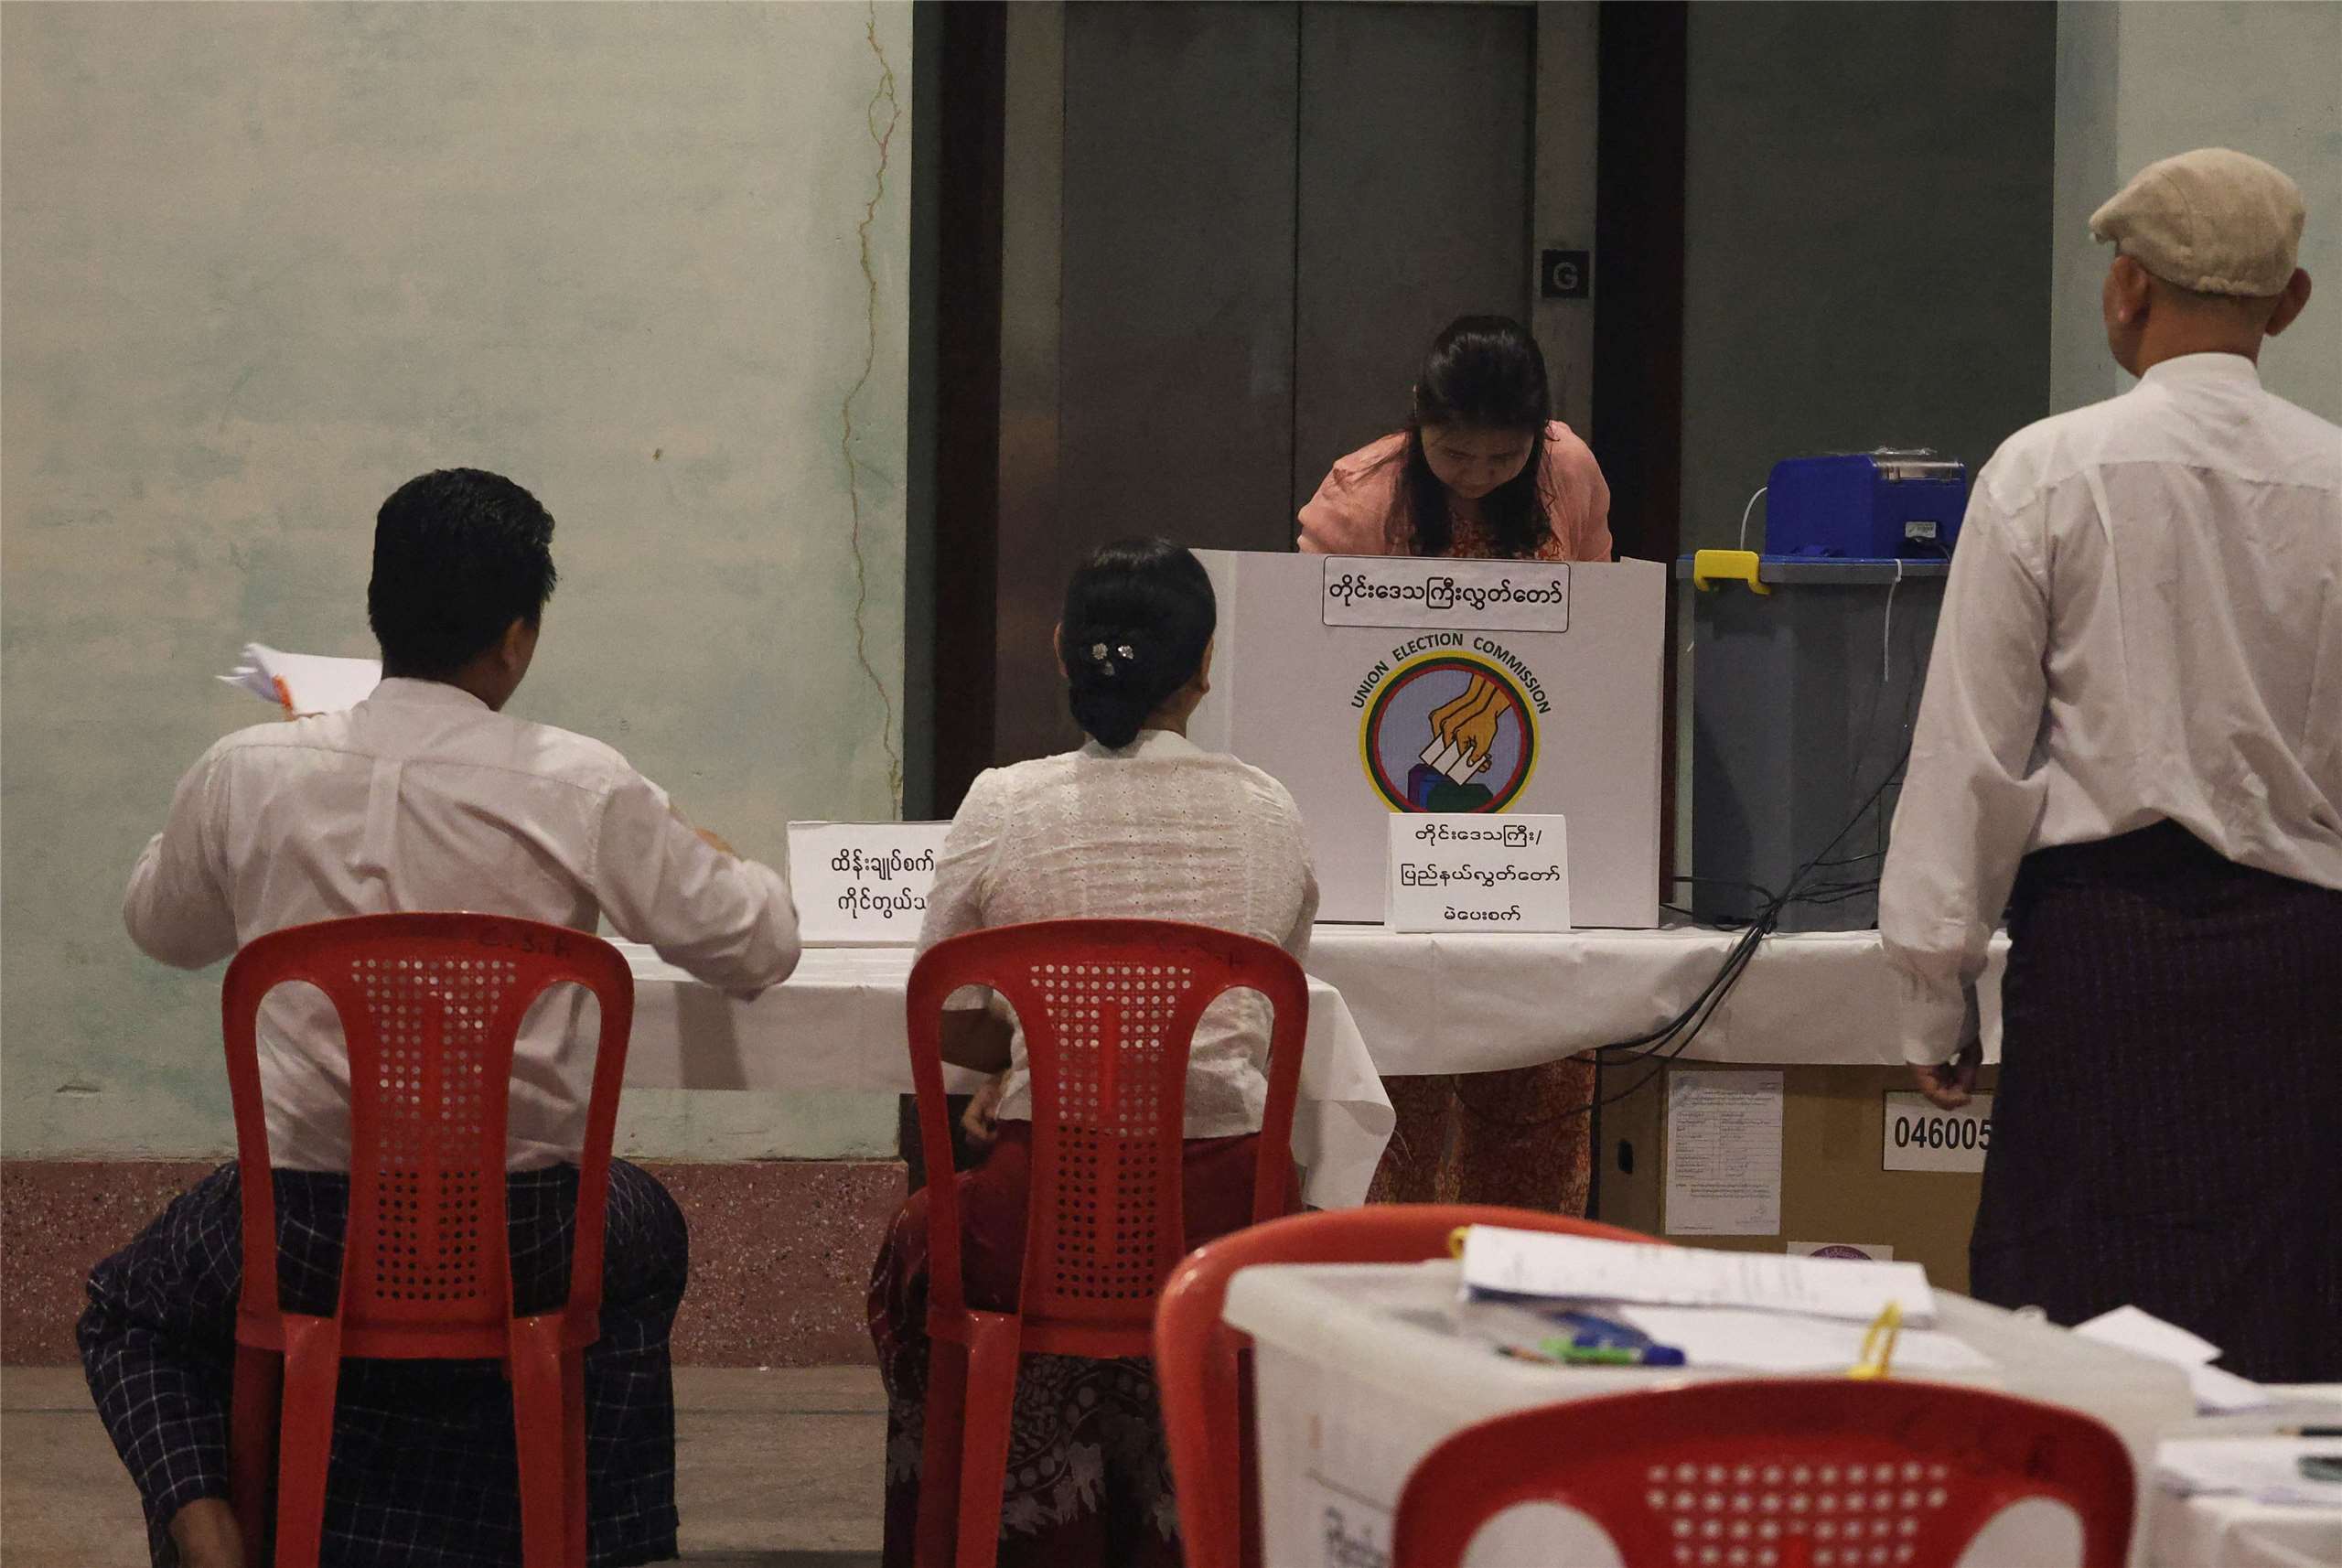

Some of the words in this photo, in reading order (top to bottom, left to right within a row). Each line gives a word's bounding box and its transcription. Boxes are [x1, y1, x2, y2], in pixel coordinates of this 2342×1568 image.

[1552, 262, 1579, 290] G
[1329, 574, 1563, 611] တိုင်းဒေသကြီးလွှတ်တော်
[1351, 660, 1390, 709] UNION
[1391, 632, 1464, 662] ELECTION
[1473, 637, 1552, 714] COMMISSION
[831, 848, 935, 881] ထိန်းချုပ်စက်
[1401, 863, 1561, 887] ပြည်နယ်လွှတ်တော်
[1444, 904, 1521, 922] မဲပေးစက်
[1894, 1116, 1993, 1151] 046005
